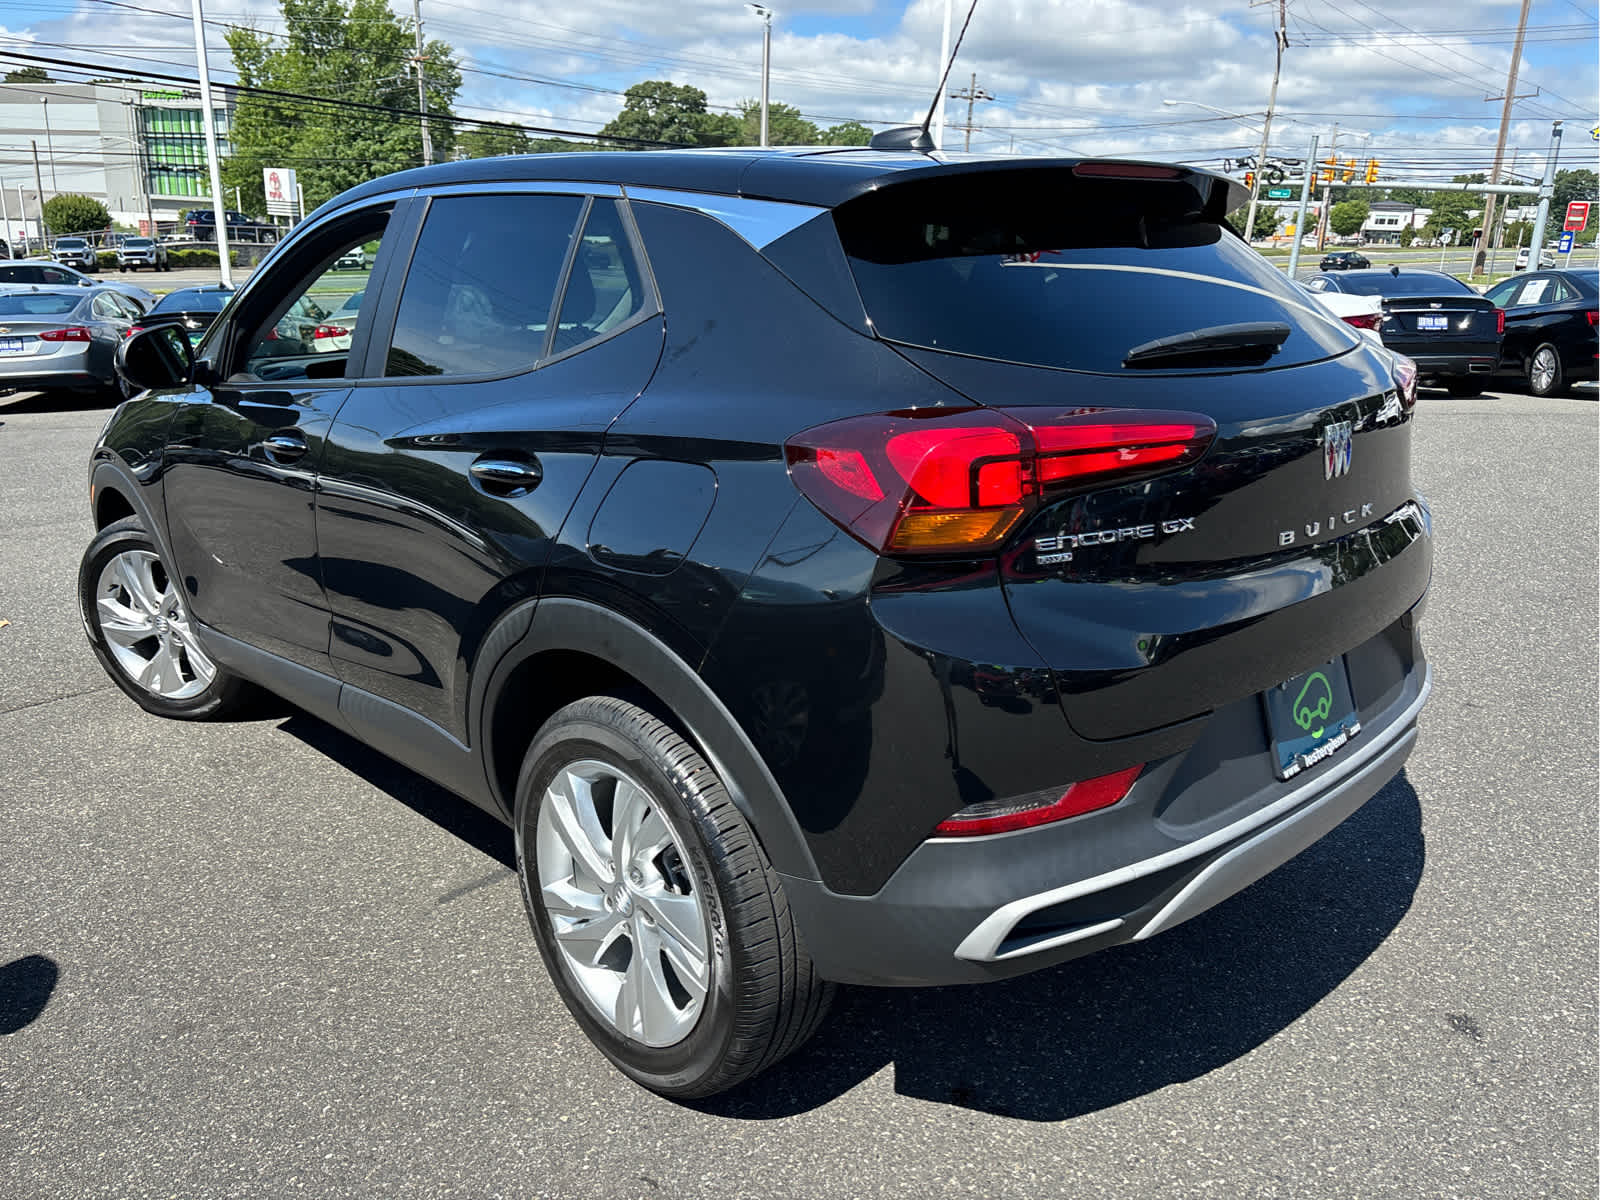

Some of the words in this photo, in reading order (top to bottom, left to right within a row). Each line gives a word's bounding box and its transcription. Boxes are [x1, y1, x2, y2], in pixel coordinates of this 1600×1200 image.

[1035, 524, 1155, 551] ENCORE
[1162, 517, 1195, 534] GX
[1279, 503, 1373, 546] BUICK
